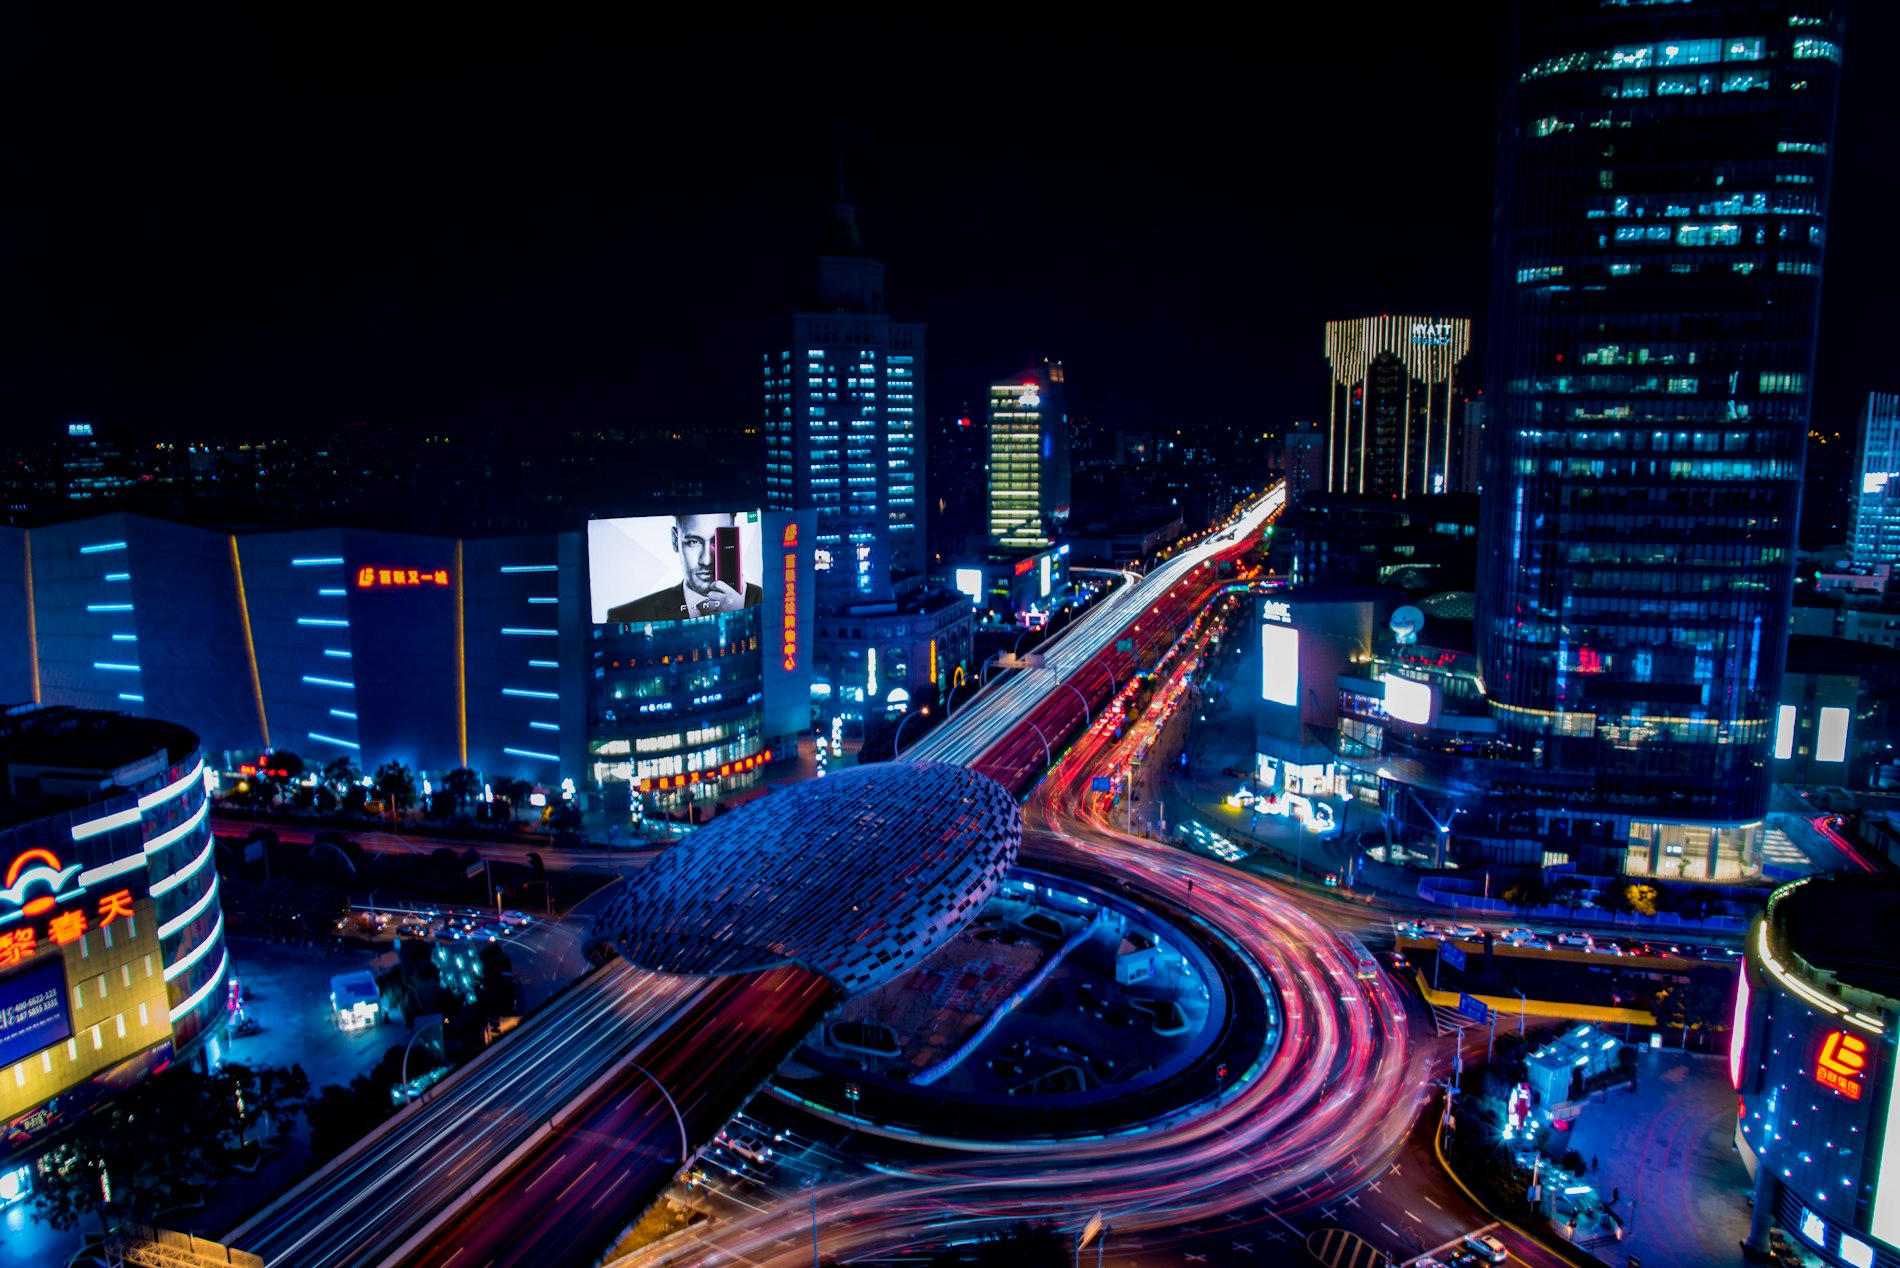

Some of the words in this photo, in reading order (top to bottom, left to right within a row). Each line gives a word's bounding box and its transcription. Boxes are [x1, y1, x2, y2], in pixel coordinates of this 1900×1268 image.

[1412, 323, 1452, 336] HYATT
[1412, 336, 1451, 345] REGENCY
[1816, 1066, 1860, 1095] 百联集团
